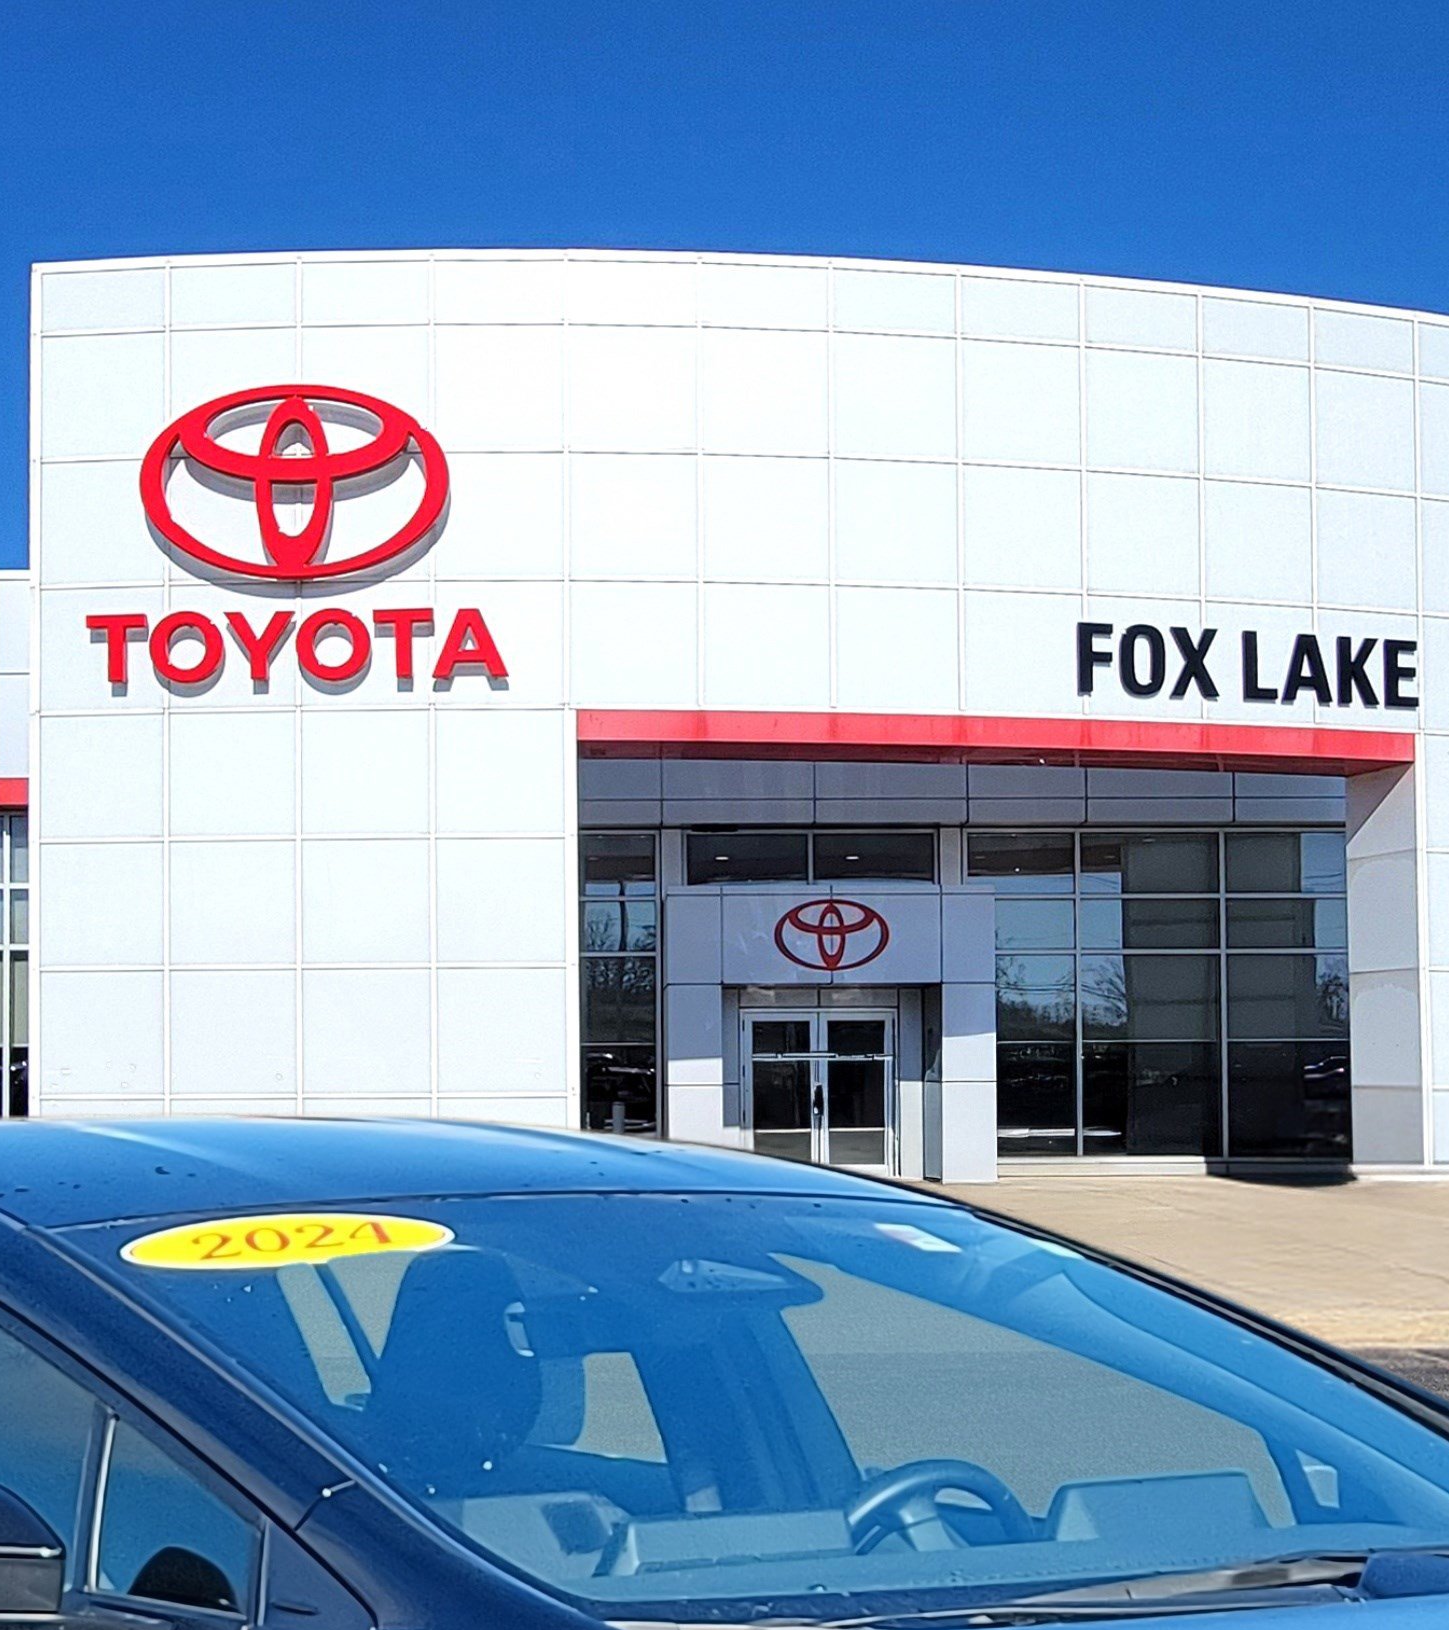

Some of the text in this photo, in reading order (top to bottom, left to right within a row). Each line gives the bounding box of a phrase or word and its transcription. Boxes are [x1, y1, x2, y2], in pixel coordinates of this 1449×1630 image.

[84, 607, 509, 685] TOYOTA
[1076, 622, 1420, 709] FOX LAKE
[191, 1221, 392, 1260] 2024
